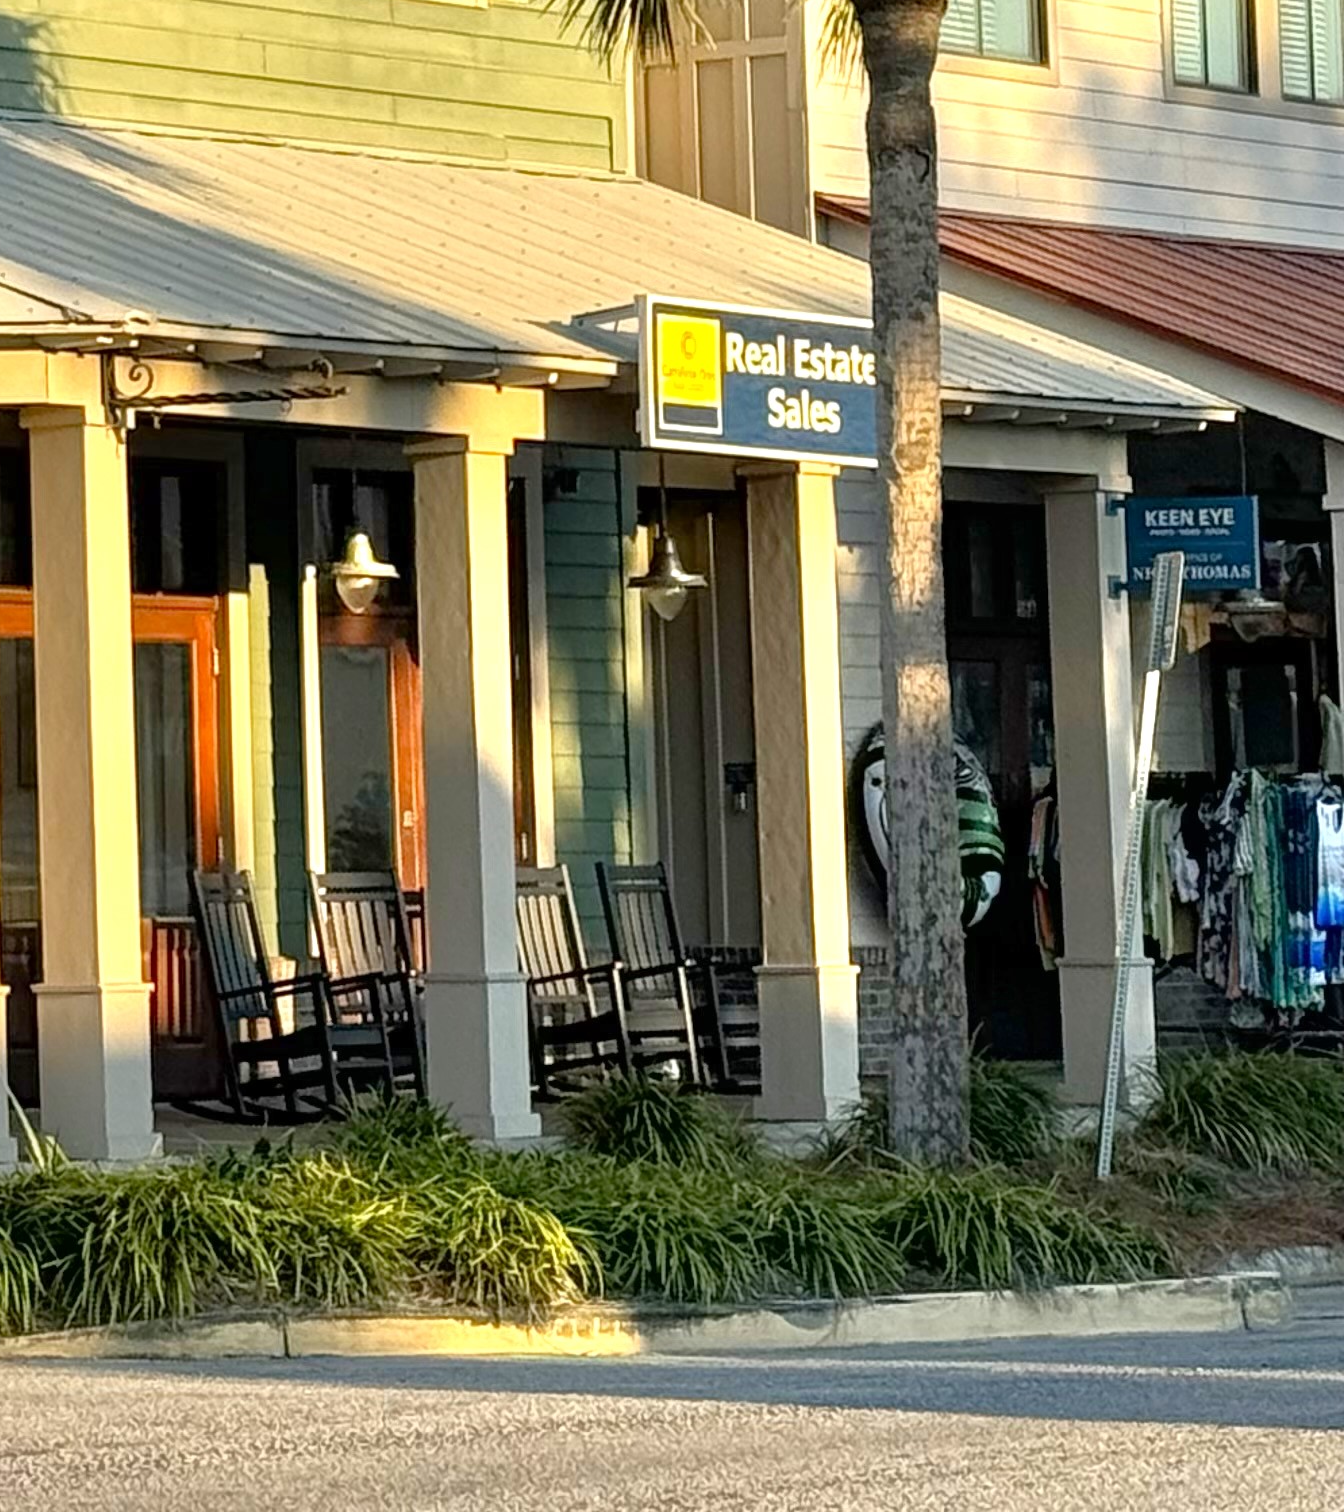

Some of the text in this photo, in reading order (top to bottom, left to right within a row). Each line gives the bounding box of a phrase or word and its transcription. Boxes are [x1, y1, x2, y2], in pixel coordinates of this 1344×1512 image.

[725, 332, 786, 376] Real
[793, 338, 877, 385] Estate
[767, 387, 841, 433] Sales
[1145, 508, 1235, 527] KEEN EYE
